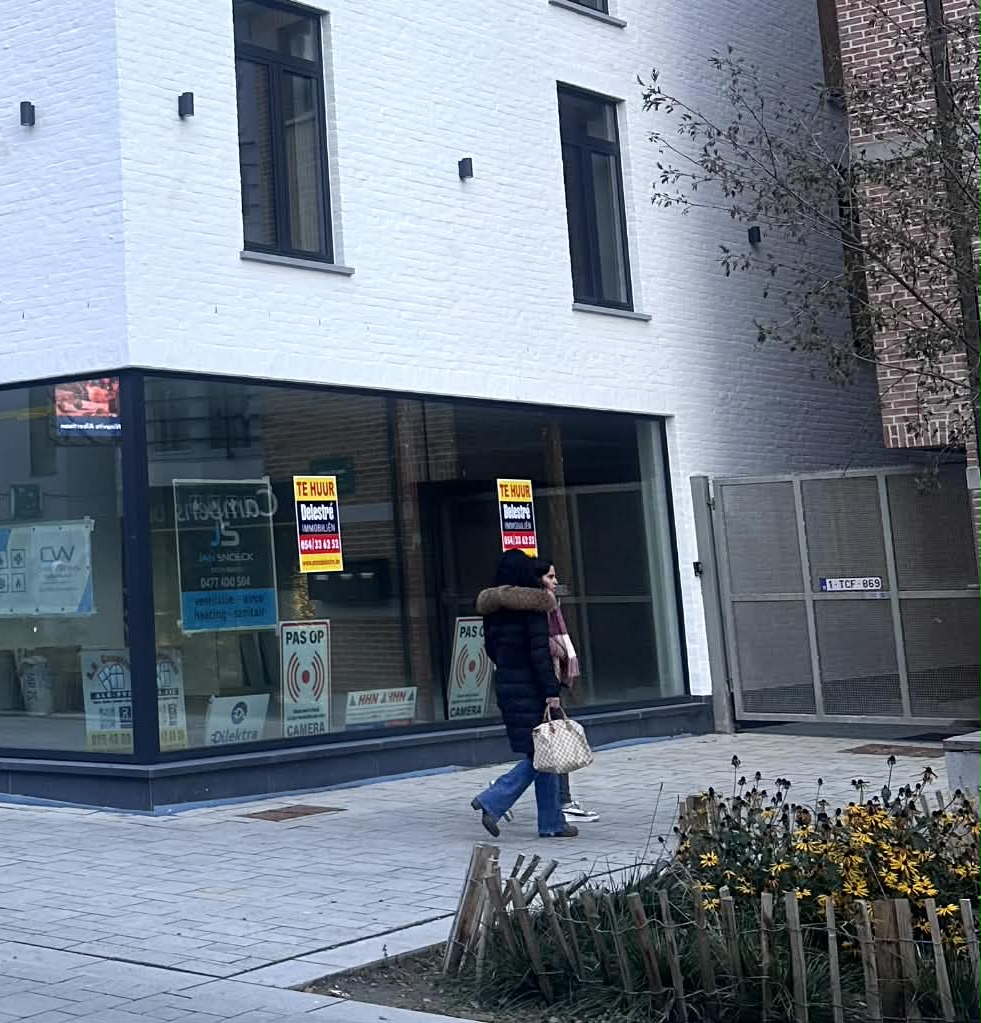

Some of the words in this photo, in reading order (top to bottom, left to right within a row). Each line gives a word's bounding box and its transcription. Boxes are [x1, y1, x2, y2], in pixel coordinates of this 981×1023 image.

[296, 482, 308, 497] TE
[310, 482, 335, 497] HUUR
[500, 484, 509, 498] TE
[511, 485, 531, 498] HUUR
[300, 502, 335, 521] Delestré
[300, 538, 322, 551] 054/33
[323, 539, 331, 550] 62
[331, 538, 339, 549] 52
[286, 631, 307, 645] PAS
[309, 630, 324, 644] OP
[459, 626, 478, 638] PAS
[358, 693, 380, 705] HHN
[449, 704, 482, 718] CAMERA
[211, 727, 259, 744] Dilektra
[286, 722, 325, 737] CAMERA
